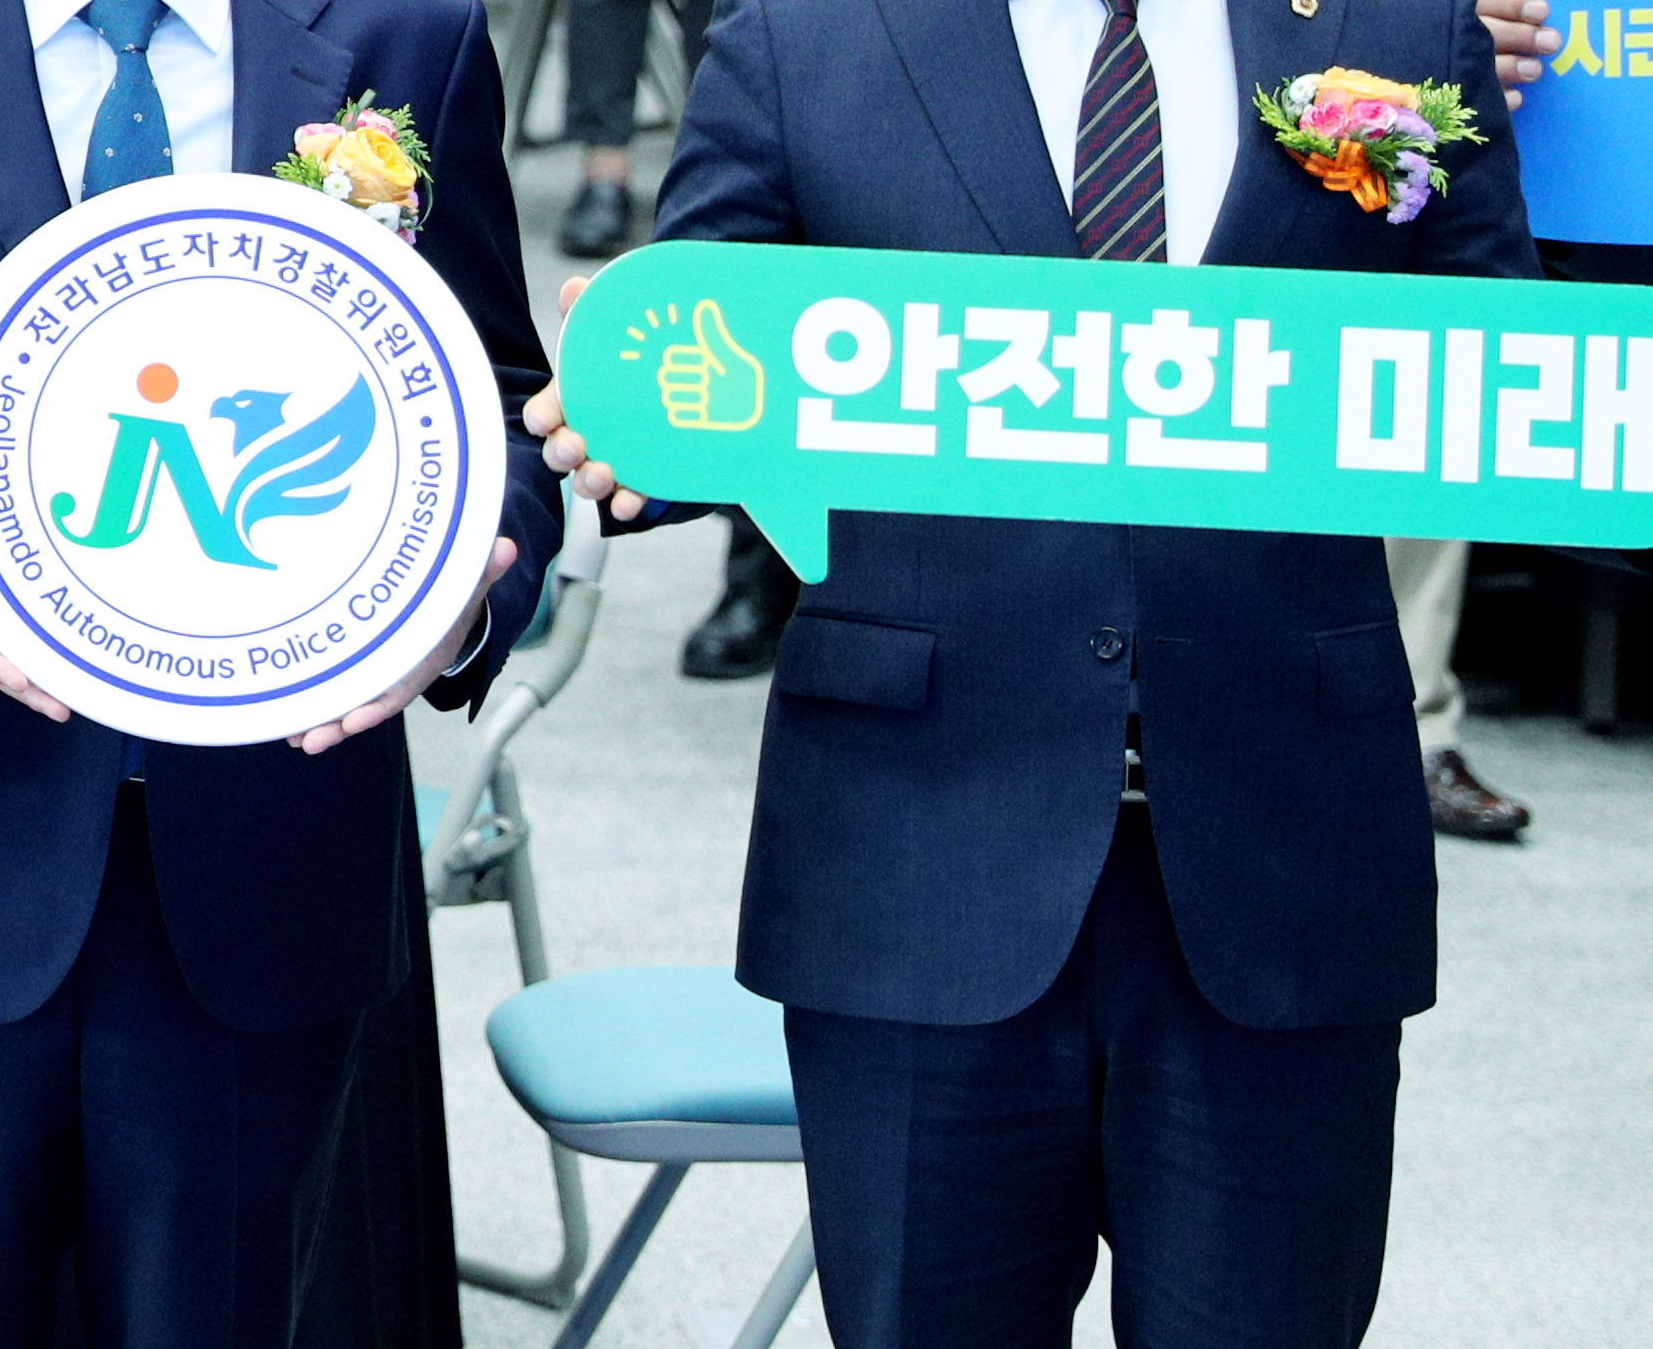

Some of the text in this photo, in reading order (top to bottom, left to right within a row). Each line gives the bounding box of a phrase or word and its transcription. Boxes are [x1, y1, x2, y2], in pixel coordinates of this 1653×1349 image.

[23, 231, 438, 403] 전라남도자치경찰위원회
[791, 295, 1653, 493] 안전한 미래
[40, 584, 235, 680] Autonomous
[246, 618, 347, 676] Police
[347, 437, 442, 624] Commission
